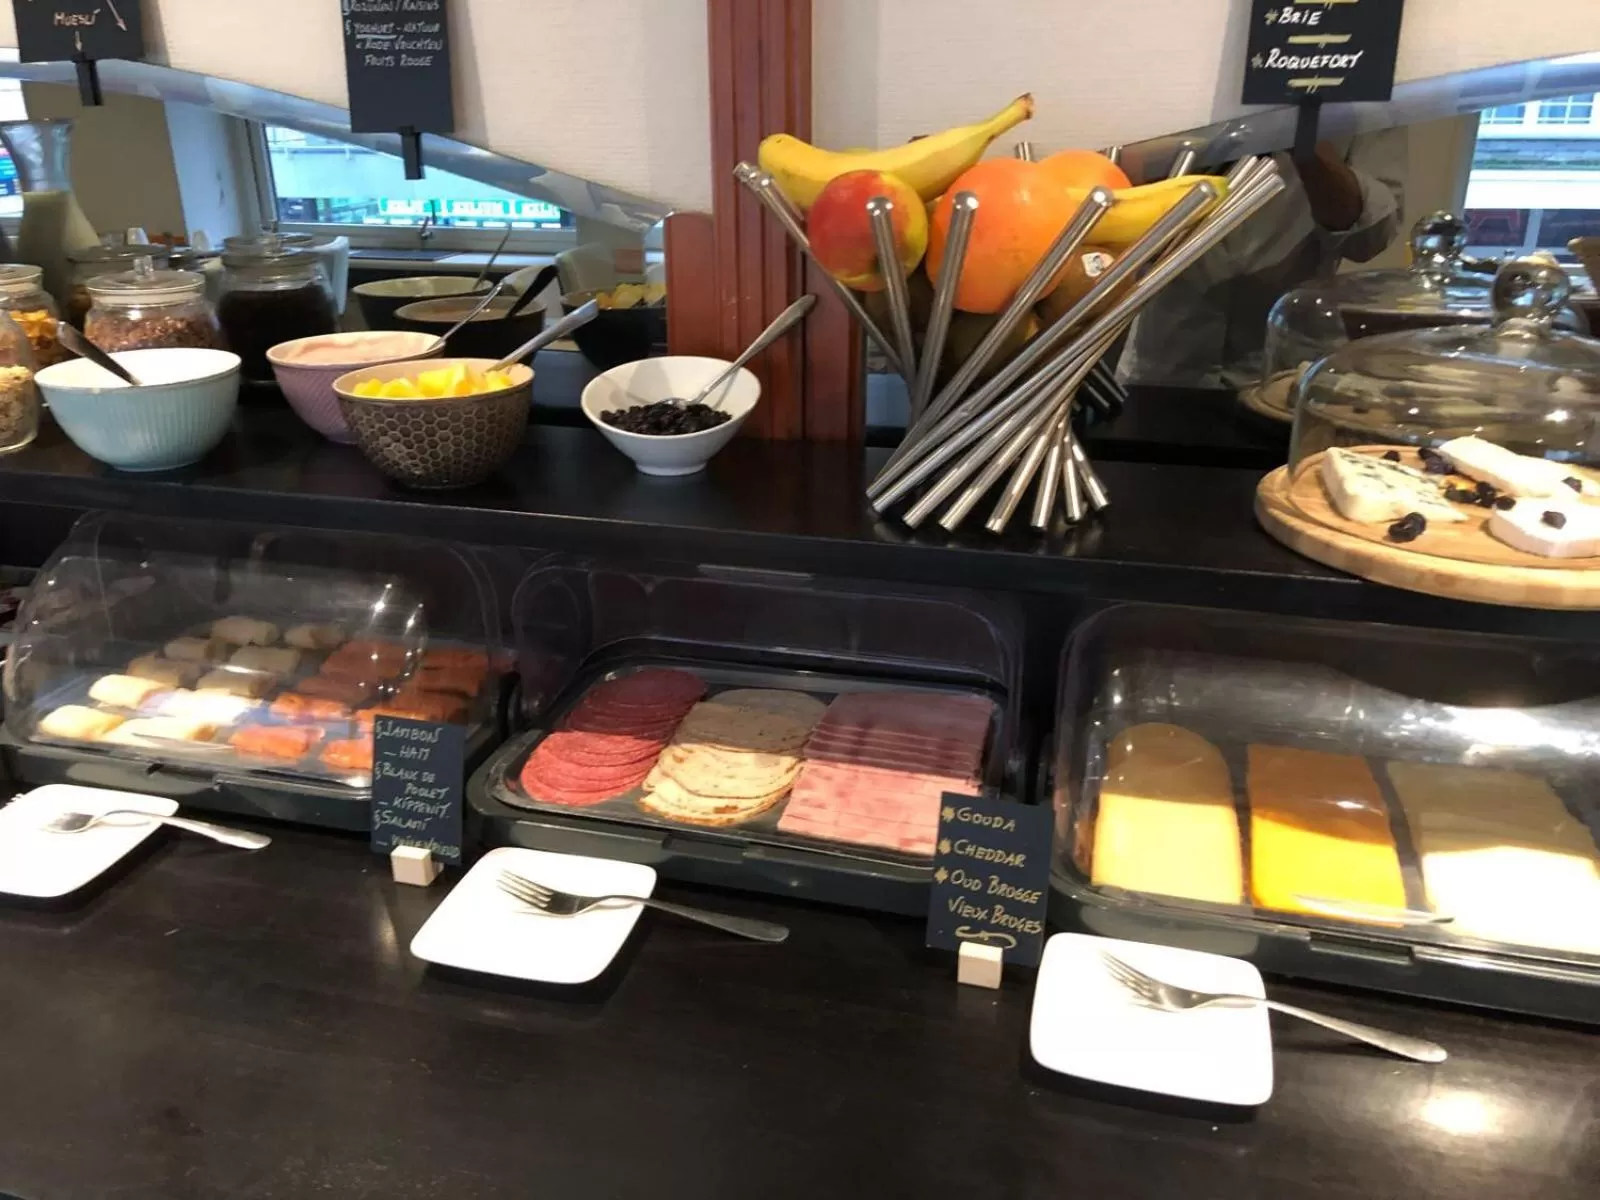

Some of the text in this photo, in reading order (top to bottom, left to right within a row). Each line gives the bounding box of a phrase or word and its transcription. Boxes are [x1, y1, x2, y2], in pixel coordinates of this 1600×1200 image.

[1278, 6, 1323, 25] BRIE
[1264, 48, 1364, 70] ROQUEFORT
[379, 720, 444, 743] JAMBON
[400, 745, 430, 760] HAM
[404, 783, 450, 799] POULET
[382, 810, 433, 830] SALAMI
[956, 807, 1016, 832] GOUDA
[953, 839, 1027, 868] CHEDDAR
[948, 896, 1043, 934] VIEUX BRUGES
